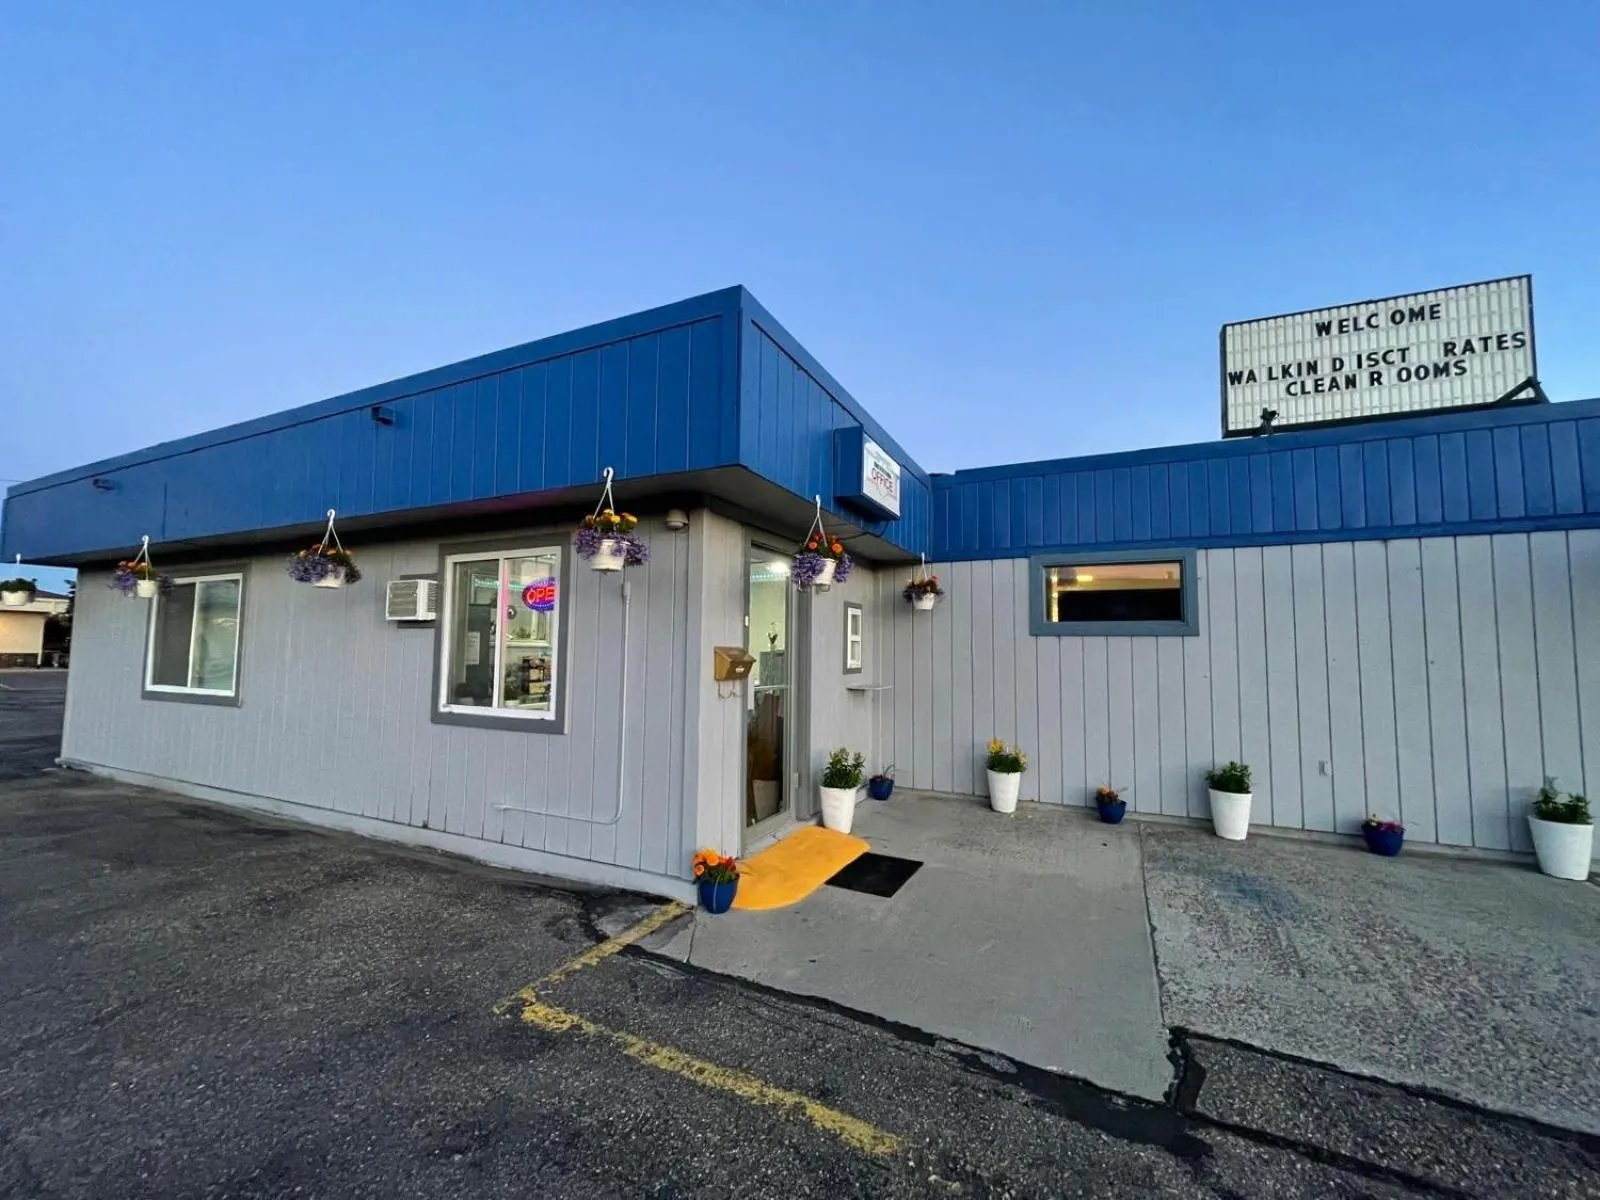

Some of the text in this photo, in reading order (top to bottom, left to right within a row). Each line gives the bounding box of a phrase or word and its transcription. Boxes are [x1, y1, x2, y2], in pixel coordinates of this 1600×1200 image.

[1443, 331, 1527, 357] RATES
[1285, 372, 1357, 397] CLEAN
[527, 586, 556, 604] OPE
